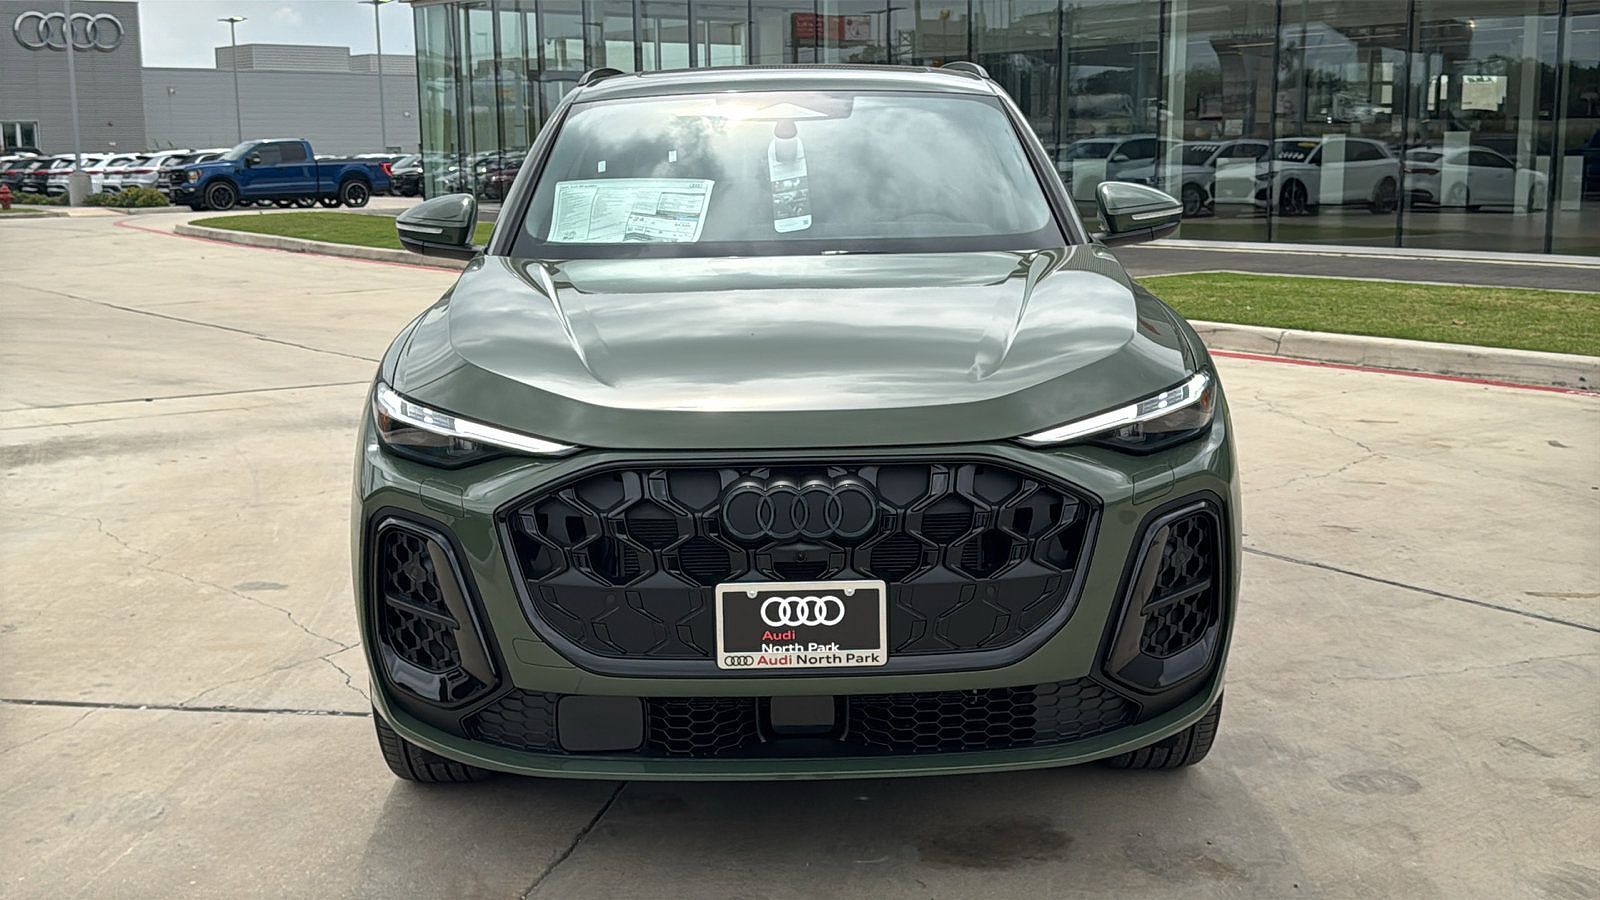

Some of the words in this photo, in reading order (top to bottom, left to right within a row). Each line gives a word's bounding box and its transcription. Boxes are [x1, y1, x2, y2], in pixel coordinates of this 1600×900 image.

[762, 630, 796, 641] Audi
[761, 643, 804, 653] North
[808, 642, 840, 652] Park
[757, 655, 792, 666] Audi
[796, 654, 842, 665] North
[846, 653, 880, 664] Park
